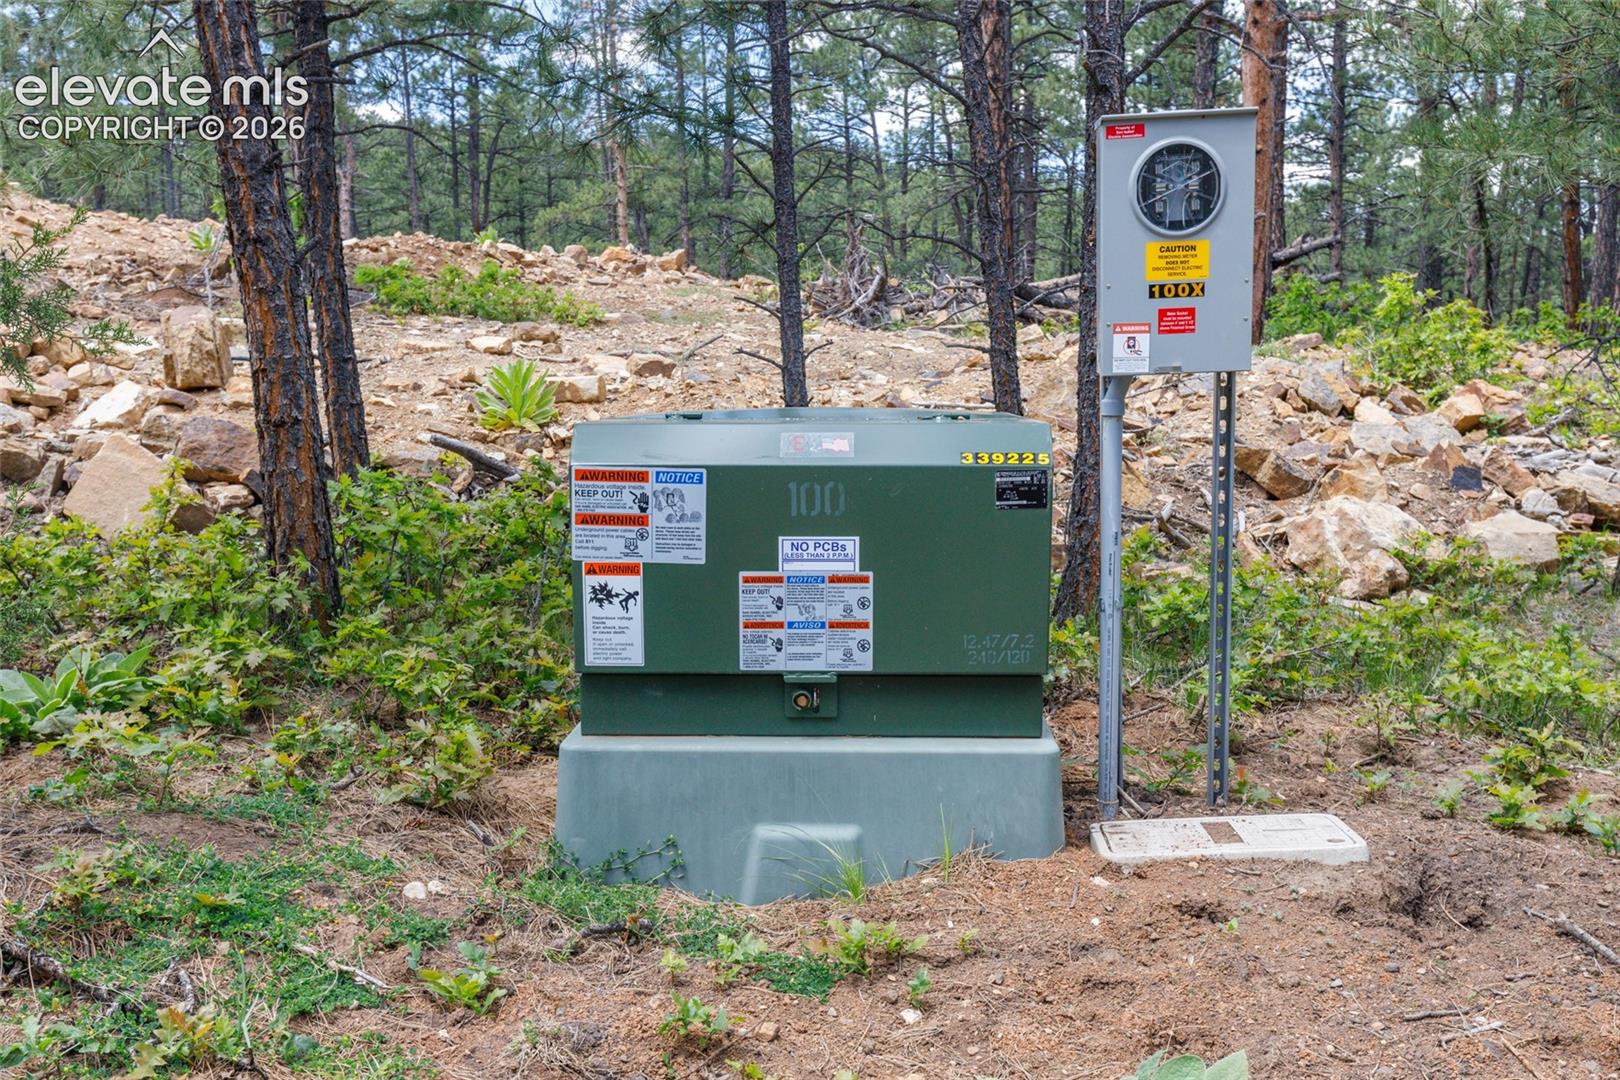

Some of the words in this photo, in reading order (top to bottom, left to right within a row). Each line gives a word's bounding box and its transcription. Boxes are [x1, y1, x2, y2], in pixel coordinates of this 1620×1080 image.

[1159, 245, 1196, 253] CAUTION
[1152, 282, 1204, 298] 100X
[961, 452, 1050, 464] 339225
[589, 471, 645, 481] WARNING
[658, 472, 700, 482] NOTICE
[601, 489, 623, 498] OUT!
[788, 480, 846, 516] 100
[589, 515, 645, 526] WARNING
[791, 542, 809, 552] NO
[813, 542, 847, 552] PCBs
[599, 564, 640, 574] WARNING
